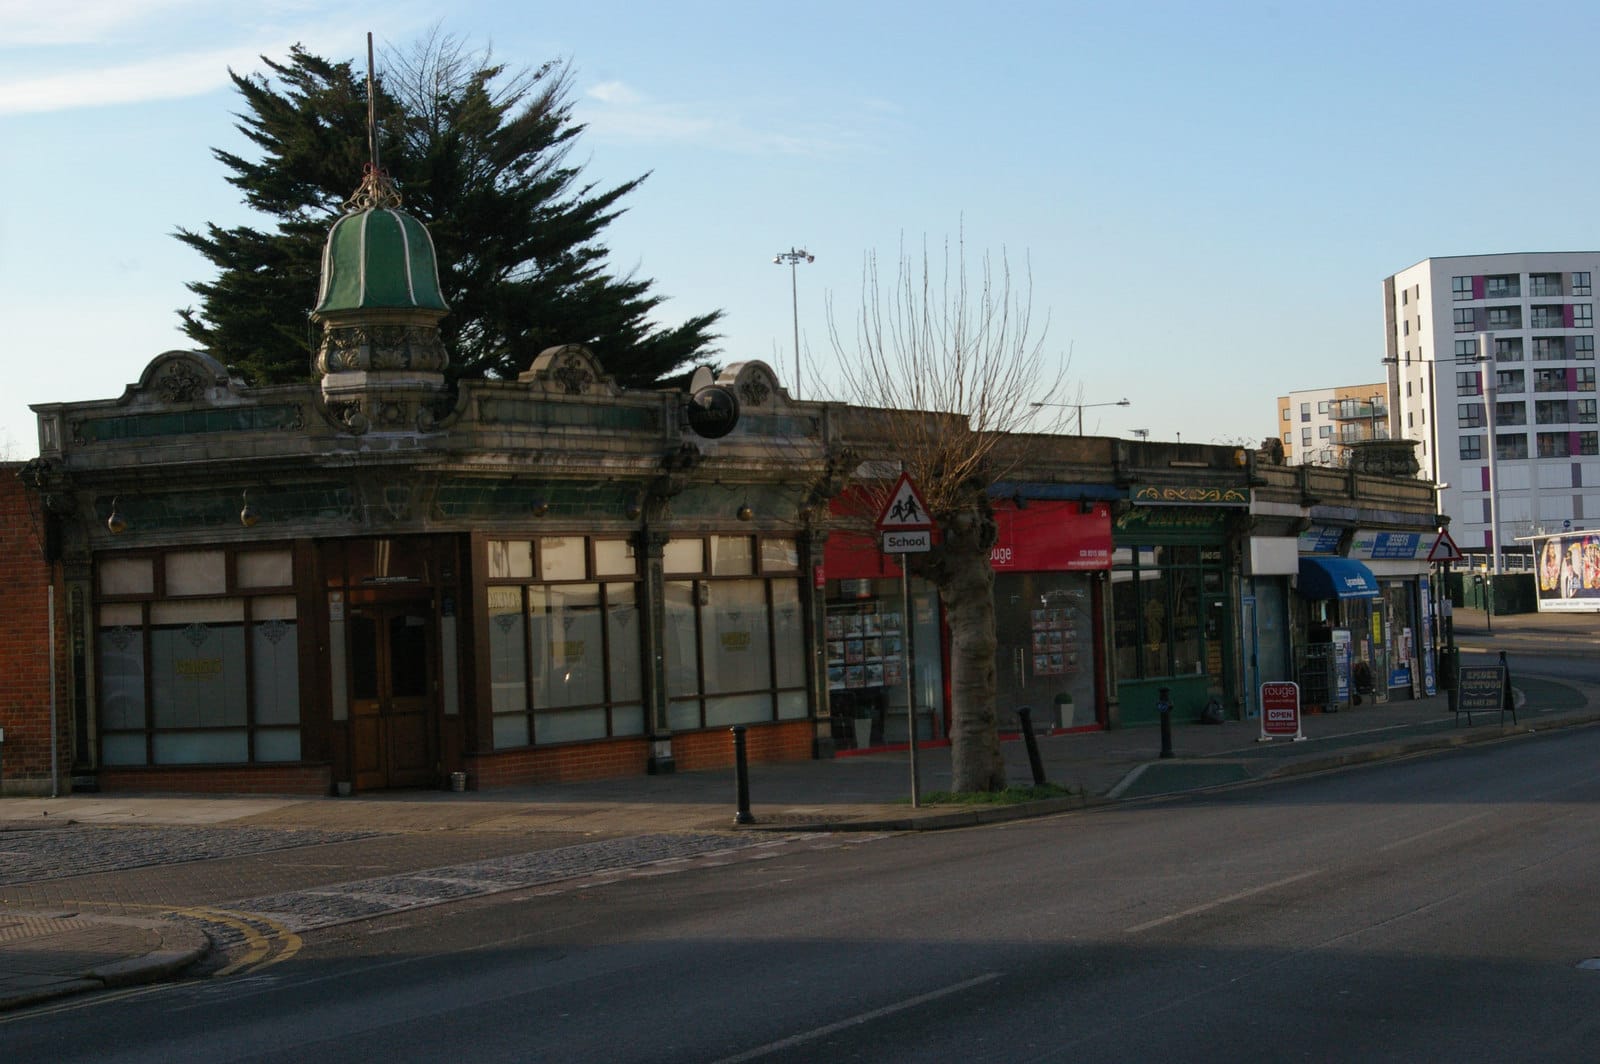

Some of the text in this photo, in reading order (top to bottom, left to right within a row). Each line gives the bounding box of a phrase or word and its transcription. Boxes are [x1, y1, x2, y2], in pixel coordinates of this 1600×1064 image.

[888, 536, 926, 547] School
[990, 547, 1013, 565] ouge
[1264, 687, 1295, 698] rouge
[1270, 711, 1292, 720] OPEN
